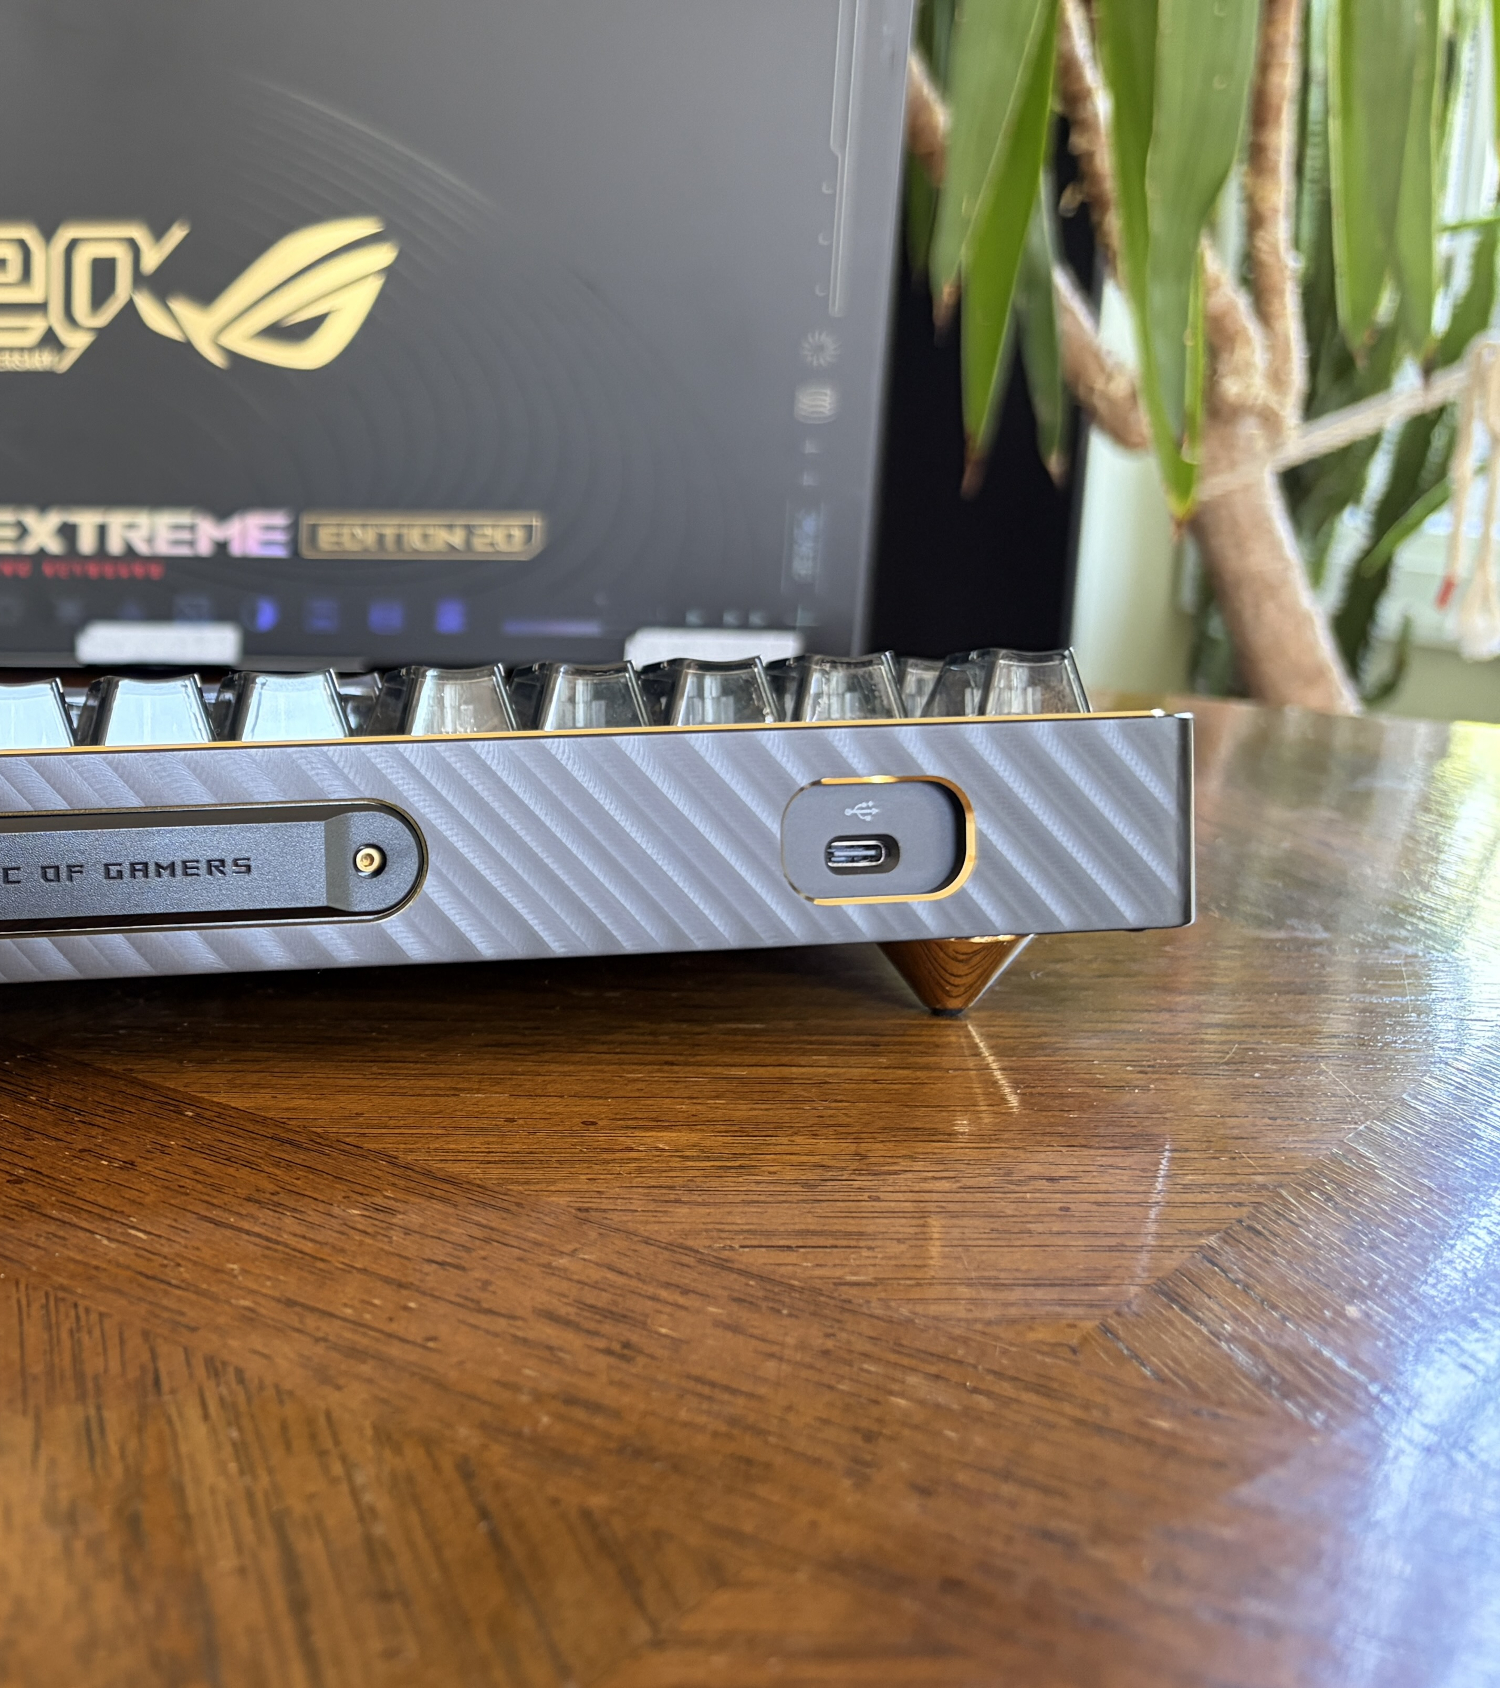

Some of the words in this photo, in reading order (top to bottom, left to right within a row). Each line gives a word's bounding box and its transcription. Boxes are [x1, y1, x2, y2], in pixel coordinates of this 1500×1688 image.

[316, 523, 468, 552] EDITION
[468, 523, 528, 552] 20
[40, 863, 85, 883] OF
[102, 856, 252, 881] GAMERS
